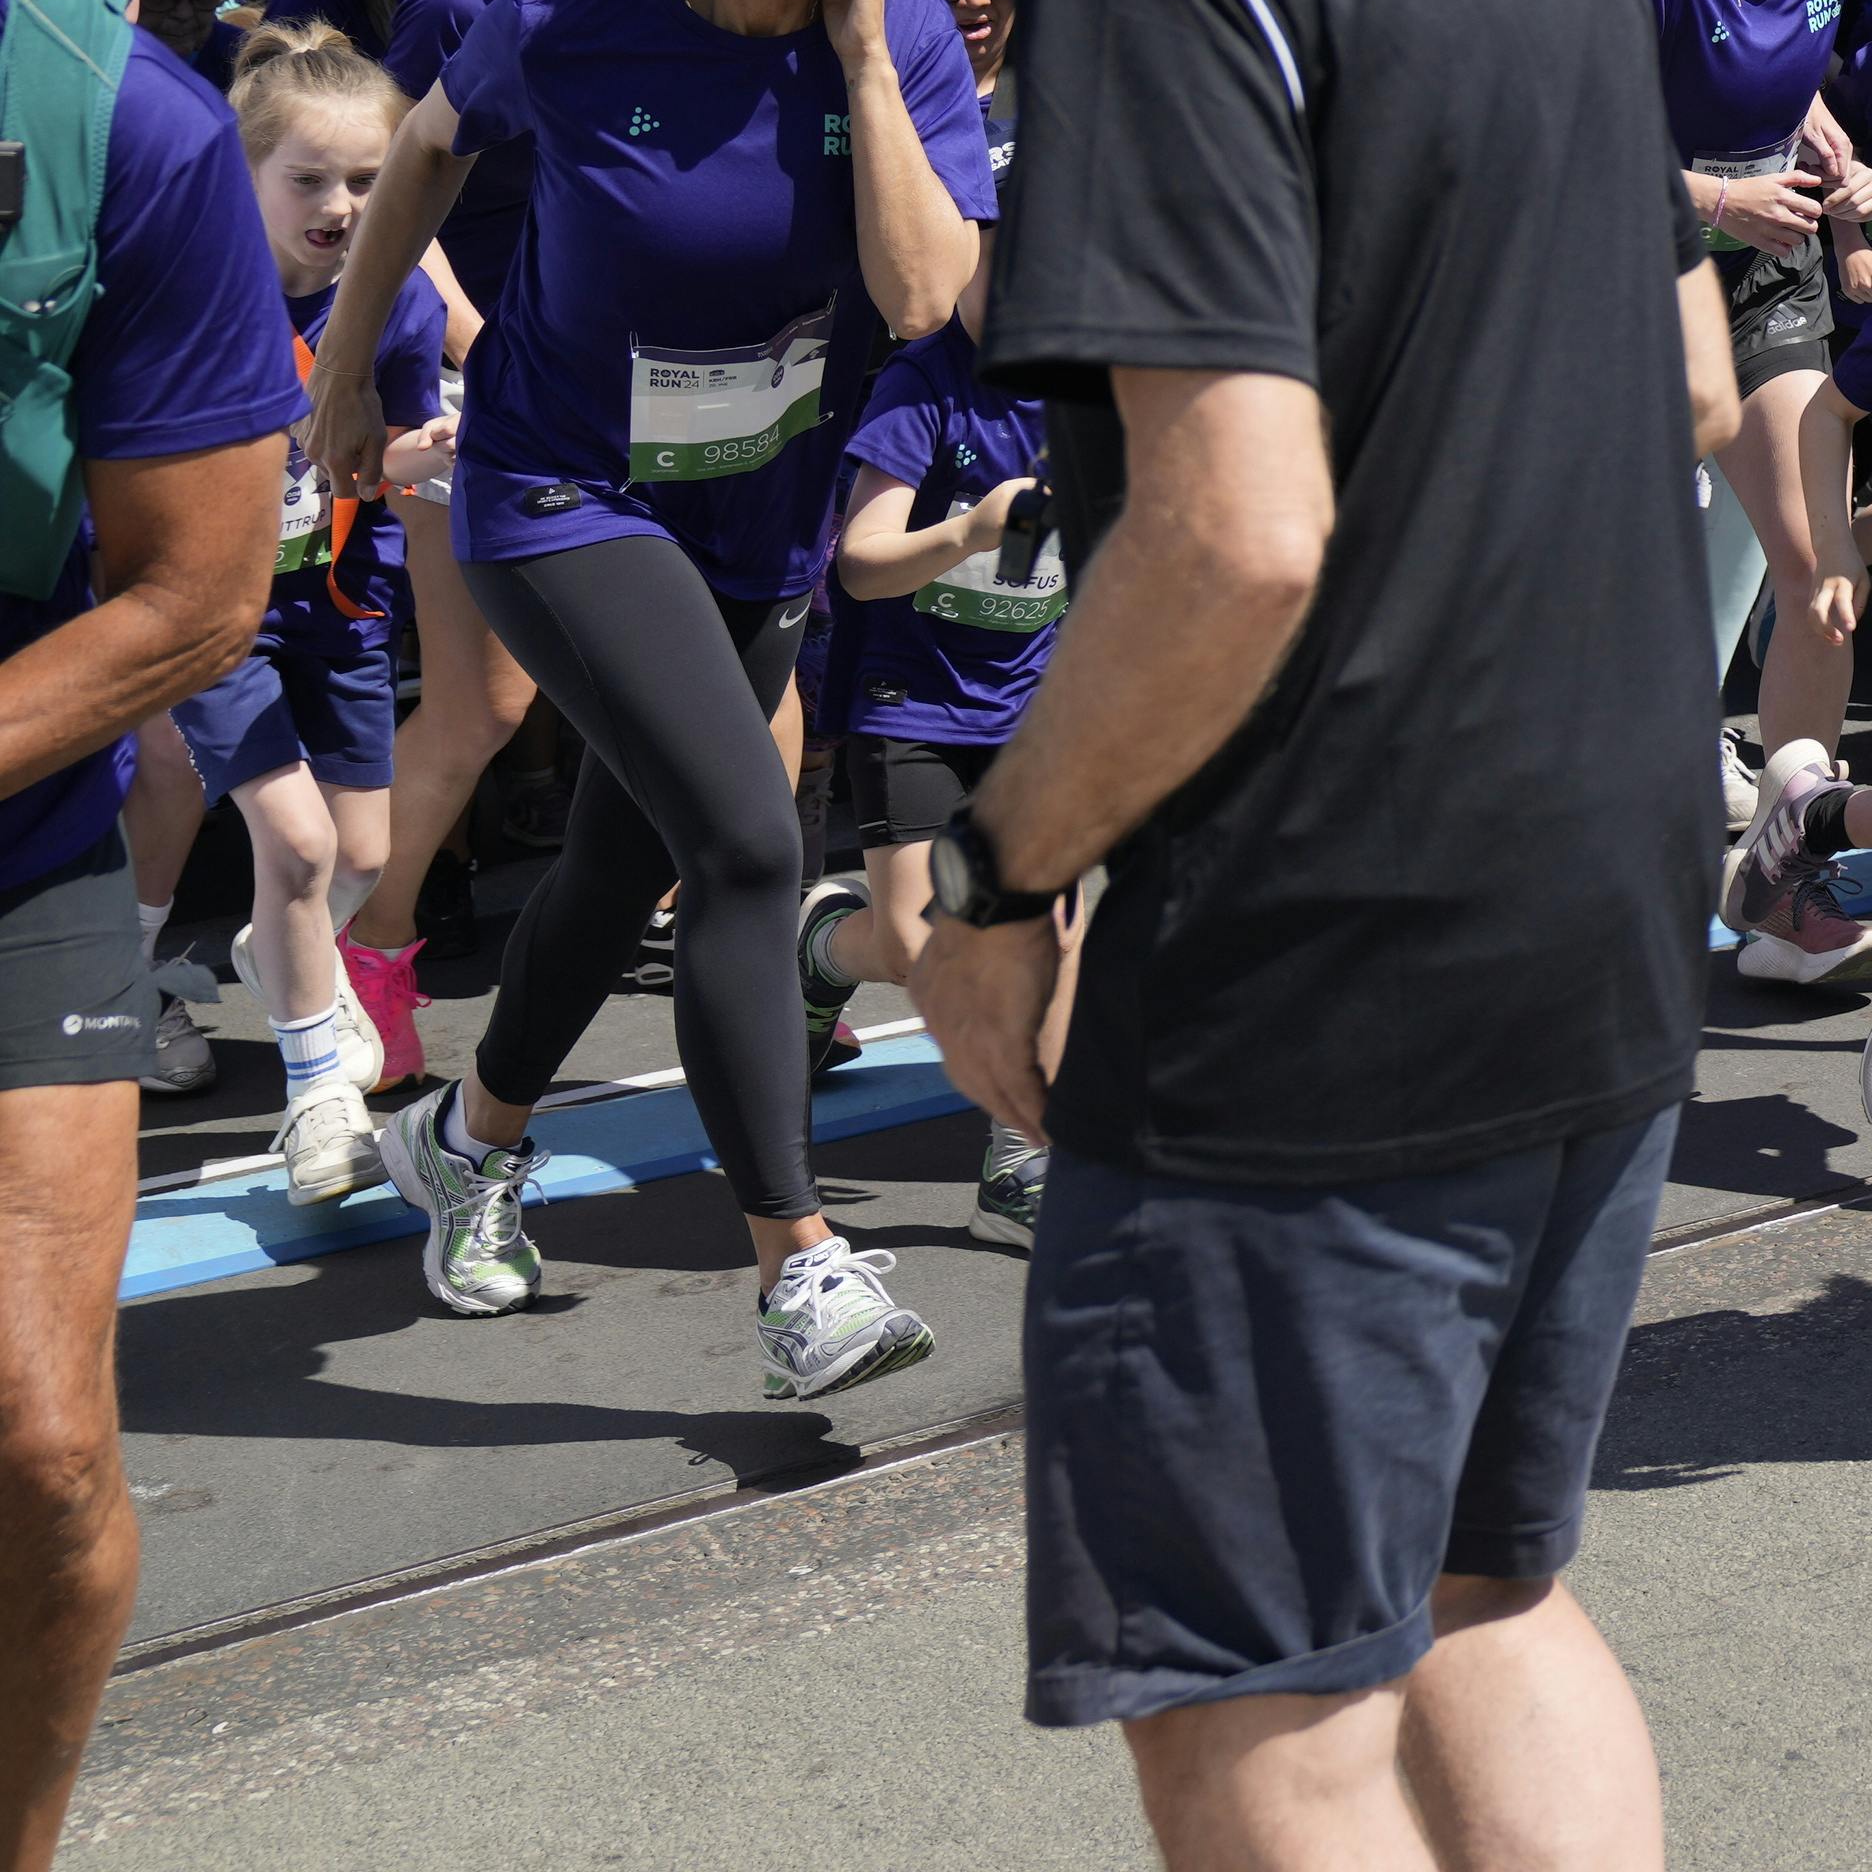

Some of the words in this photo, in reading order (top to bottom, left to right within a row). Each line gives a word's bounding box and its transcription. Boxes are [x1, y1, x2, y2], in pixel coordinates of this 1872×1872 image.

[1808, 7, 1833, 34] RUN
[1767, 316, 1808, 335] adidas
[650, 368, 700, 379] ROYAL
[657, 451, 675, 467] C
[704, 424, 780, 465] 98584
[937, 592, 956, 608] C
[979, 597, 1050, 620] 92625
